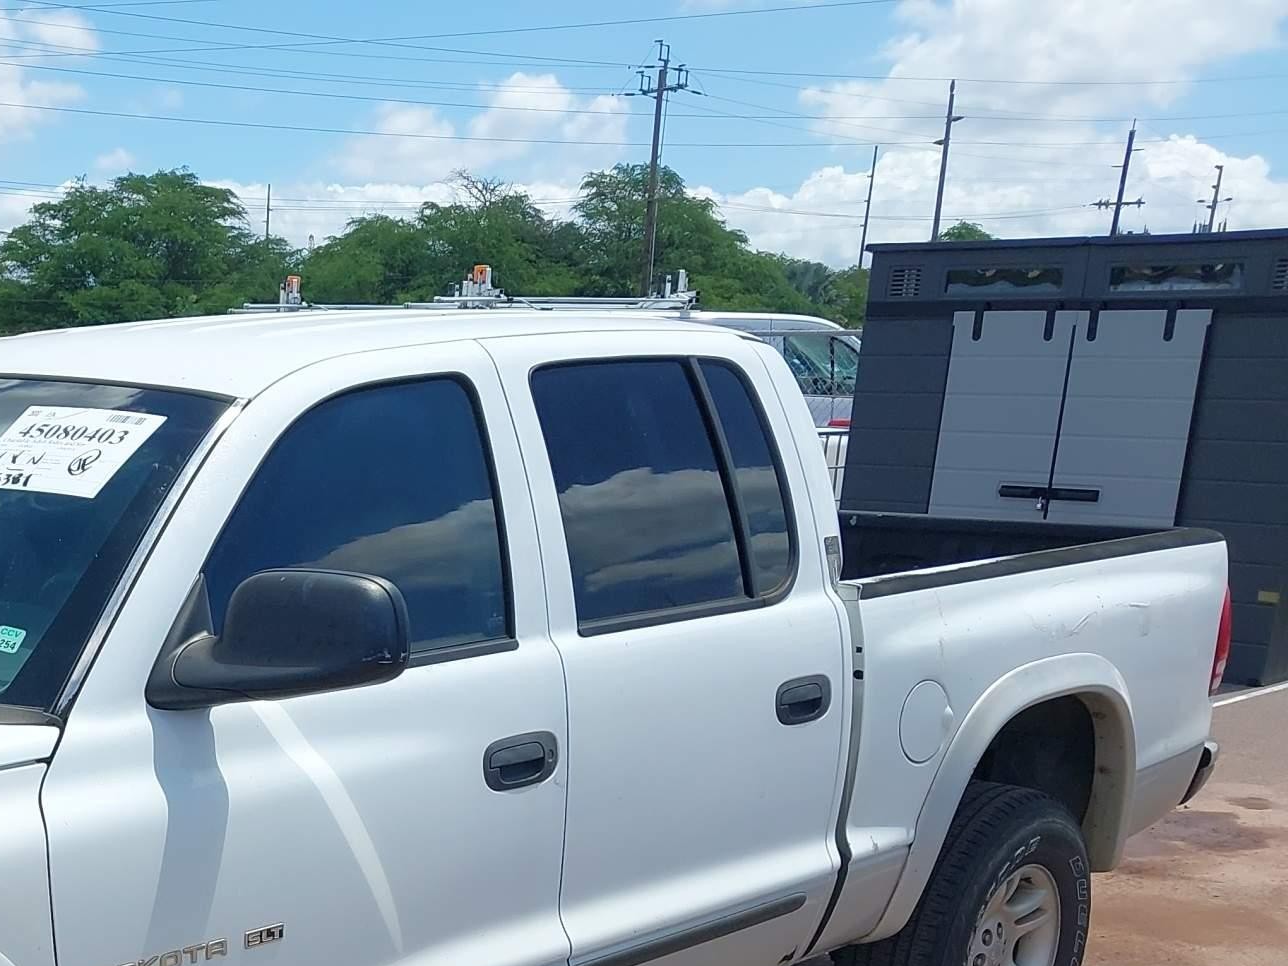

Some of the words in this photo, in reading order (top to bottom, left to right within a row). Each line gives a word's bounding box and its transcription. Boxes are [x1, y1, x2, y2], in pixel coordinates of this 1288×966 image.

[19, 423, 129, 445] 45080403
[0, 627, 23, 638] CCV
[247, 924, 284, 947] SLT
